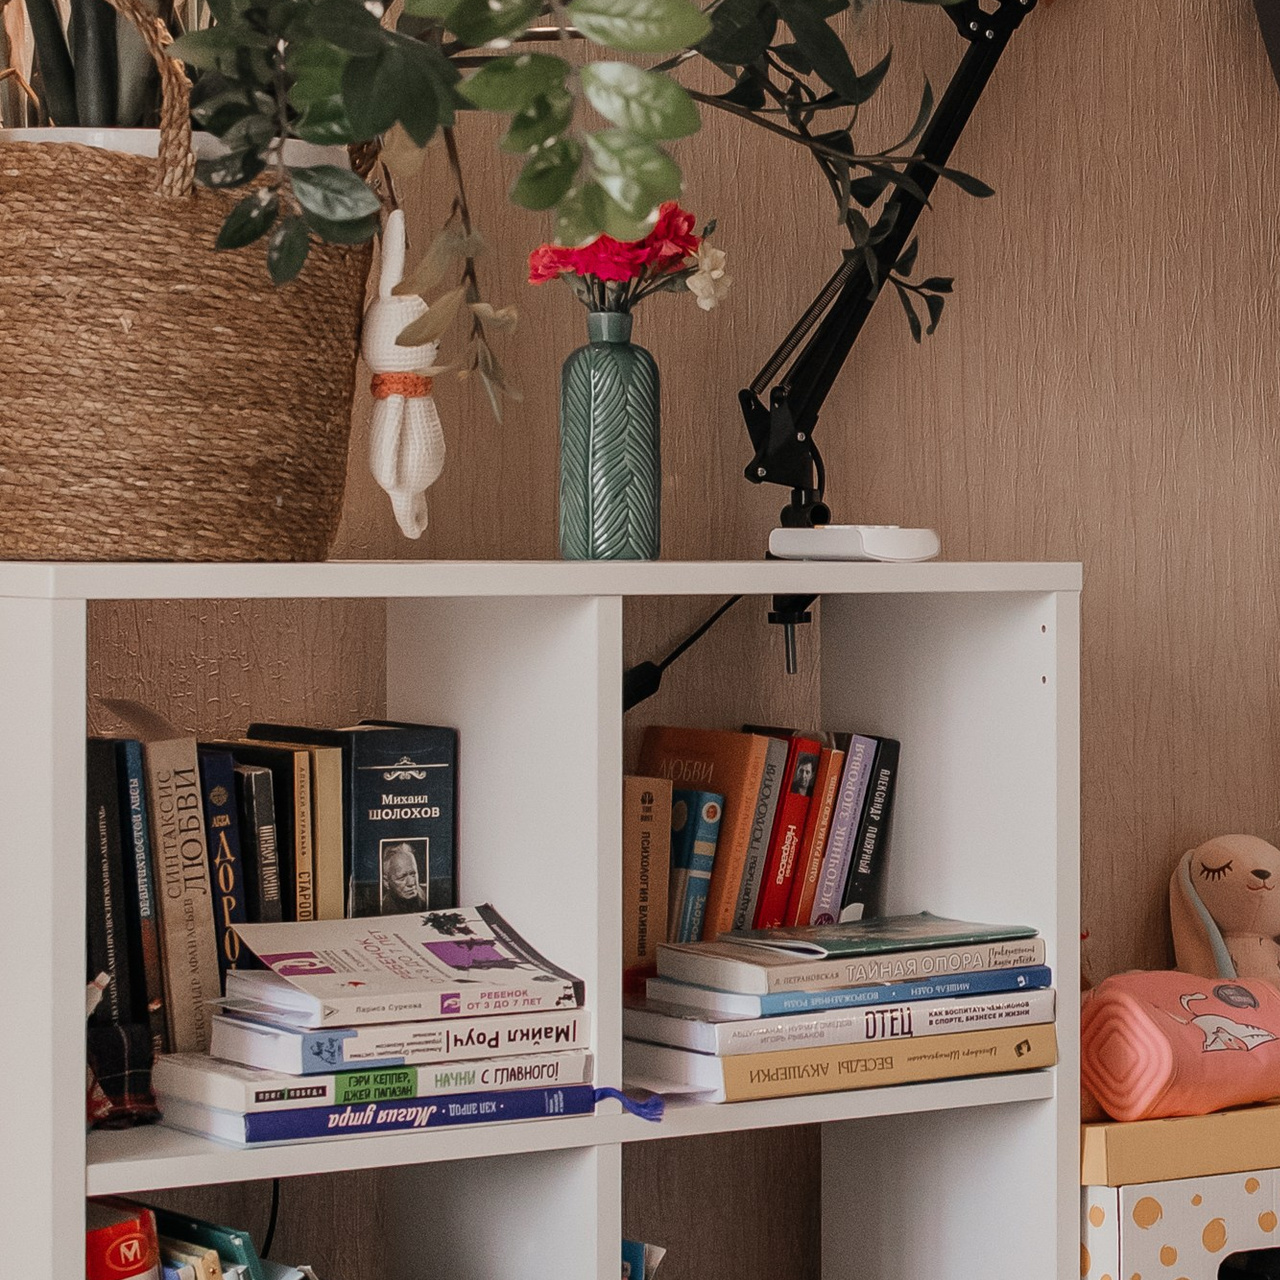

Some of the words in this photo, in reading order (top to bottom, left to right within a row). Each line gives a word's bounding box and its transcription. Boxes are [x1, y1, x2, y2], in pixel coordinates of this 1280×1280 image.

[660, 758, 714, 784] ЛЮБВИ
[382, 794, 429, 805] Михаил
[824, 774, 839, 805] ЖИЗНЬ
[868, 768, 890, 821] АЛЕКСАНДР
[369, 807, 440, 820] ШОЛОХОВ
[750, 763, 777, 852] ПСИХОЛОГИЯ
[820, 805, 831, 825] ВСЮ
[157, 771, 178, 899] СИНТАКСИС
[175, 766, 207, 895] ЛЮБВИ
[816, 825, 850, 908] ИСТОЧНИК
[835, 742, 867, 820] ЗДОРОВЬЯ
[817, 826, 826, 839] НА
[776, 824, 796, 885] Некрасов
[813, 840, 824, 857] РАЗ
[857, 825, 879, 875] ПОЛЯРНЫЙ
[639, 831, 650, 904] ПСИХОЛОГИЯ
[214, 831, 240, 970] ДОРО
[186, 898, 199, 974] АФАНАСЬЕВ
[637, 905, 648, 957] ВЛИЯНИЯ
[784, 973, 839, 984] ПЕТРАНОВСКАЯ
[845, 958, 917, 982] ТАЙНАЯ
[921, 952, 984, 973] ОПОРА
[480, 989, 528, 999] РЕБЕНОК
[911, 986, 934, 996] ОДЕН
[936, 983, 970, 994] МИШЕЛЬ
[356, 1005, 386, 1013] Лариса
[389, 1002, 423, 1011] Суркова
[467, 1001, 481, 1011] ОТ
[484, 1001, 490, 1009] 3
[493, 1000, 509, 1010] ДО
[513, 998, 520, 1007] 7
[523, 997, 542, 1006] ЛЕТ
[784, 999, 808, 1008] РОДЫ
[811, 992, 879, 1006] ВОЗРОЖДЕННЫЕ
[929, 1010, 944, 1018] КАК
[945, 1006, 986, 1016] ВОСПИТАТЬ
[966, 1013, 997, 1022] БИЗНЕСЕ
[1005, 1009, 1030, 1018] ЖИЗНИ
[865, 1006, 913, 1039] ОТЕЦ
[453, 1030, 499, 1048] Роуч
[508, 1024, 570, 1046] Майкл
[761, 1035, 786, 1044] ИГОРЬ
[788, 1031, 825, 1042] РЫБАКОВ
[434, 1070, 476, 1088] НАЧНИ
[481, 1070, 490, 1084] С
[494, 1062, 559, 1085] ГЛАВНОГО!
[750, 1062, 829, 1084] АКУШЕРКИ
[838, 1056, 893, 1075] БЕСЕДЫ
[349, 1076, 370, 1087] ГЭРИ
[343, 1089, 370, 1103] ДЖЕЙ
[373, 1086, 412, 1099] ПАПАЗАН
[328, 1104, 376, 1128] утра
[376, 1105, 437, 1126] Магия
[449, 1104, 478, 1117] ЭЛРОД
[480, 1103, 497, 1115] ХЭЛ
